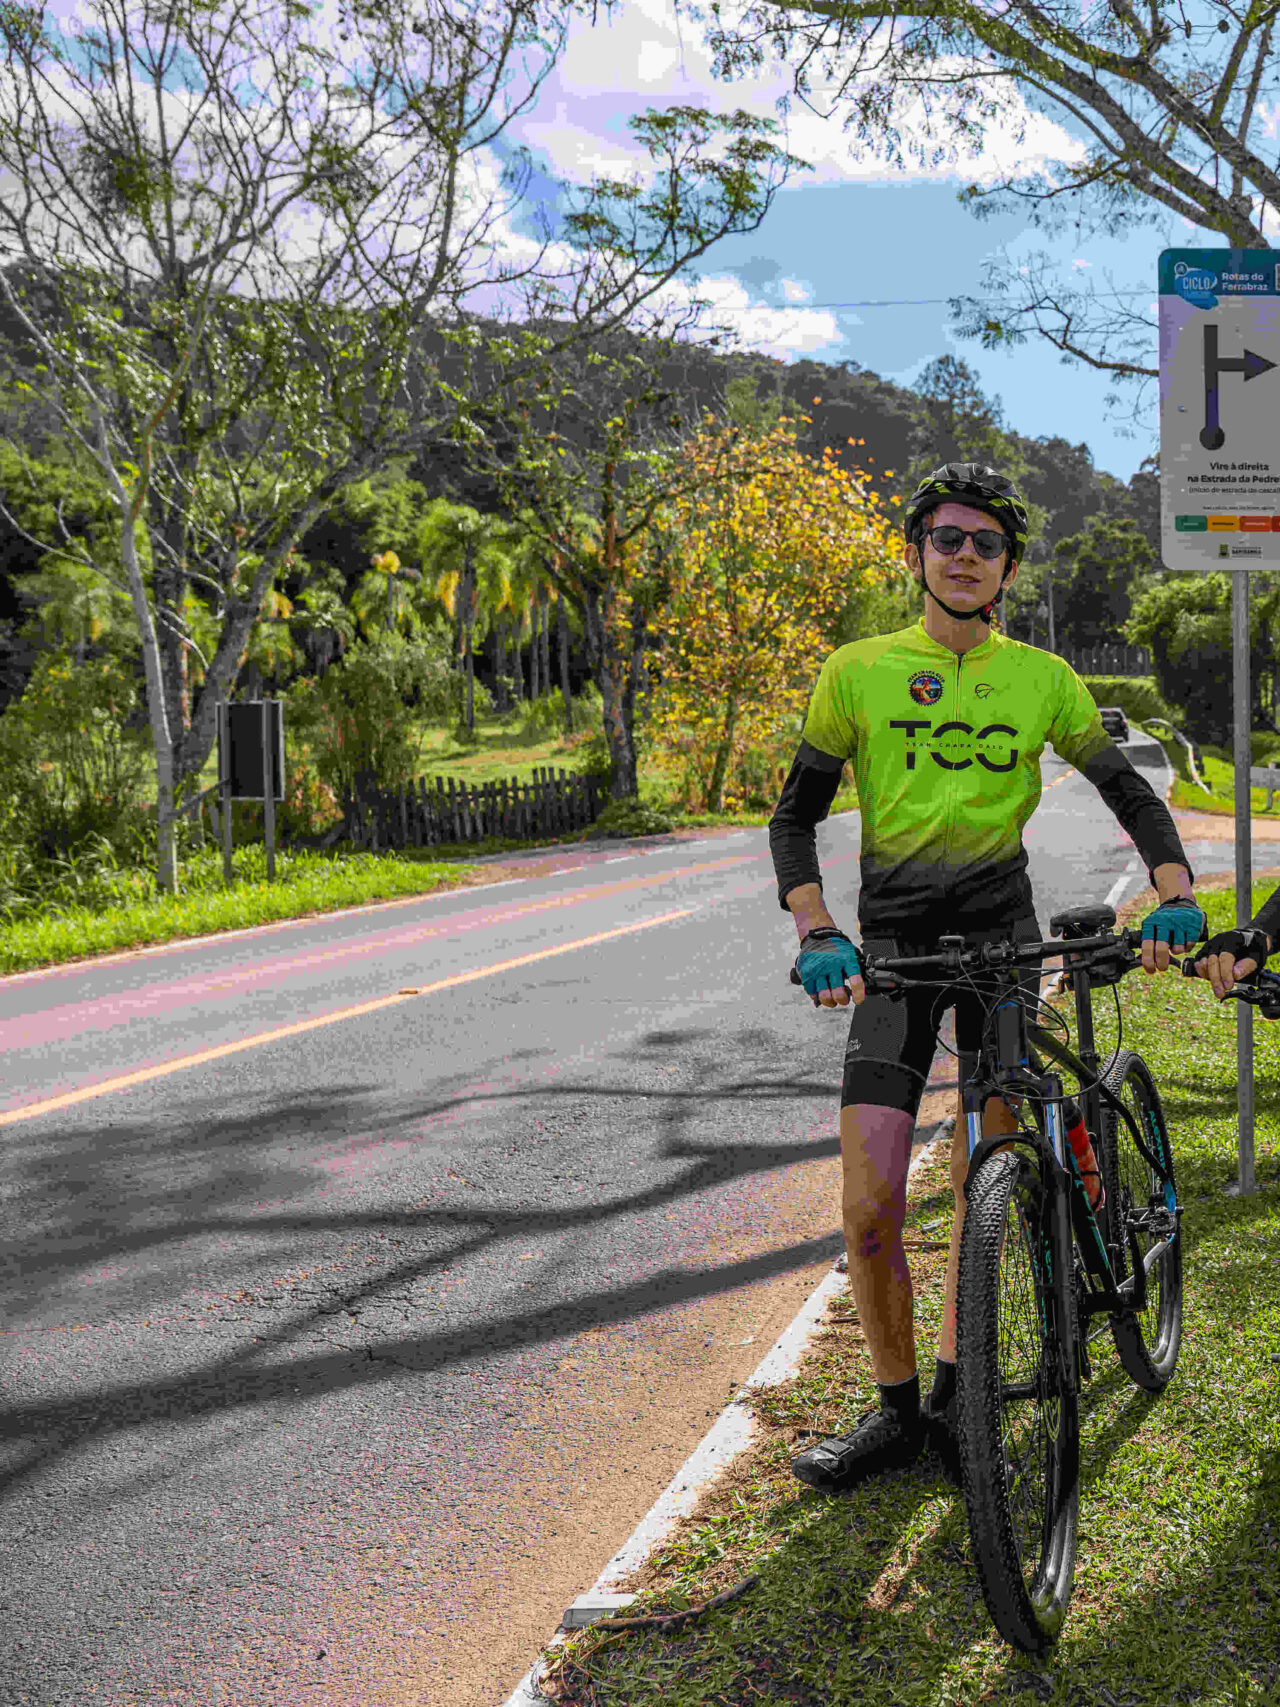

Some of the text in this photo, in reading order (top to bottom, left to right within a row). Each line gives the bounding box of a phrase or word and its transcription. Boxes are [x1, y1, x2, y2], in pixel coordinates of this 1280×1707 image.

[1221, 272, 1264, 281] Rotas do
[1182, 277, 1210, 290] CICLO
[1222, 282, 1268, 291] Ferrabraz
[1210, 462, 1229, 471] Vire
[1237, 462, 1269, 471] direita
[1201, 475, 1237, 483] Estrada
[1238, 475, 1250, 483] da
[889, 720, 1019, 773] TCG
